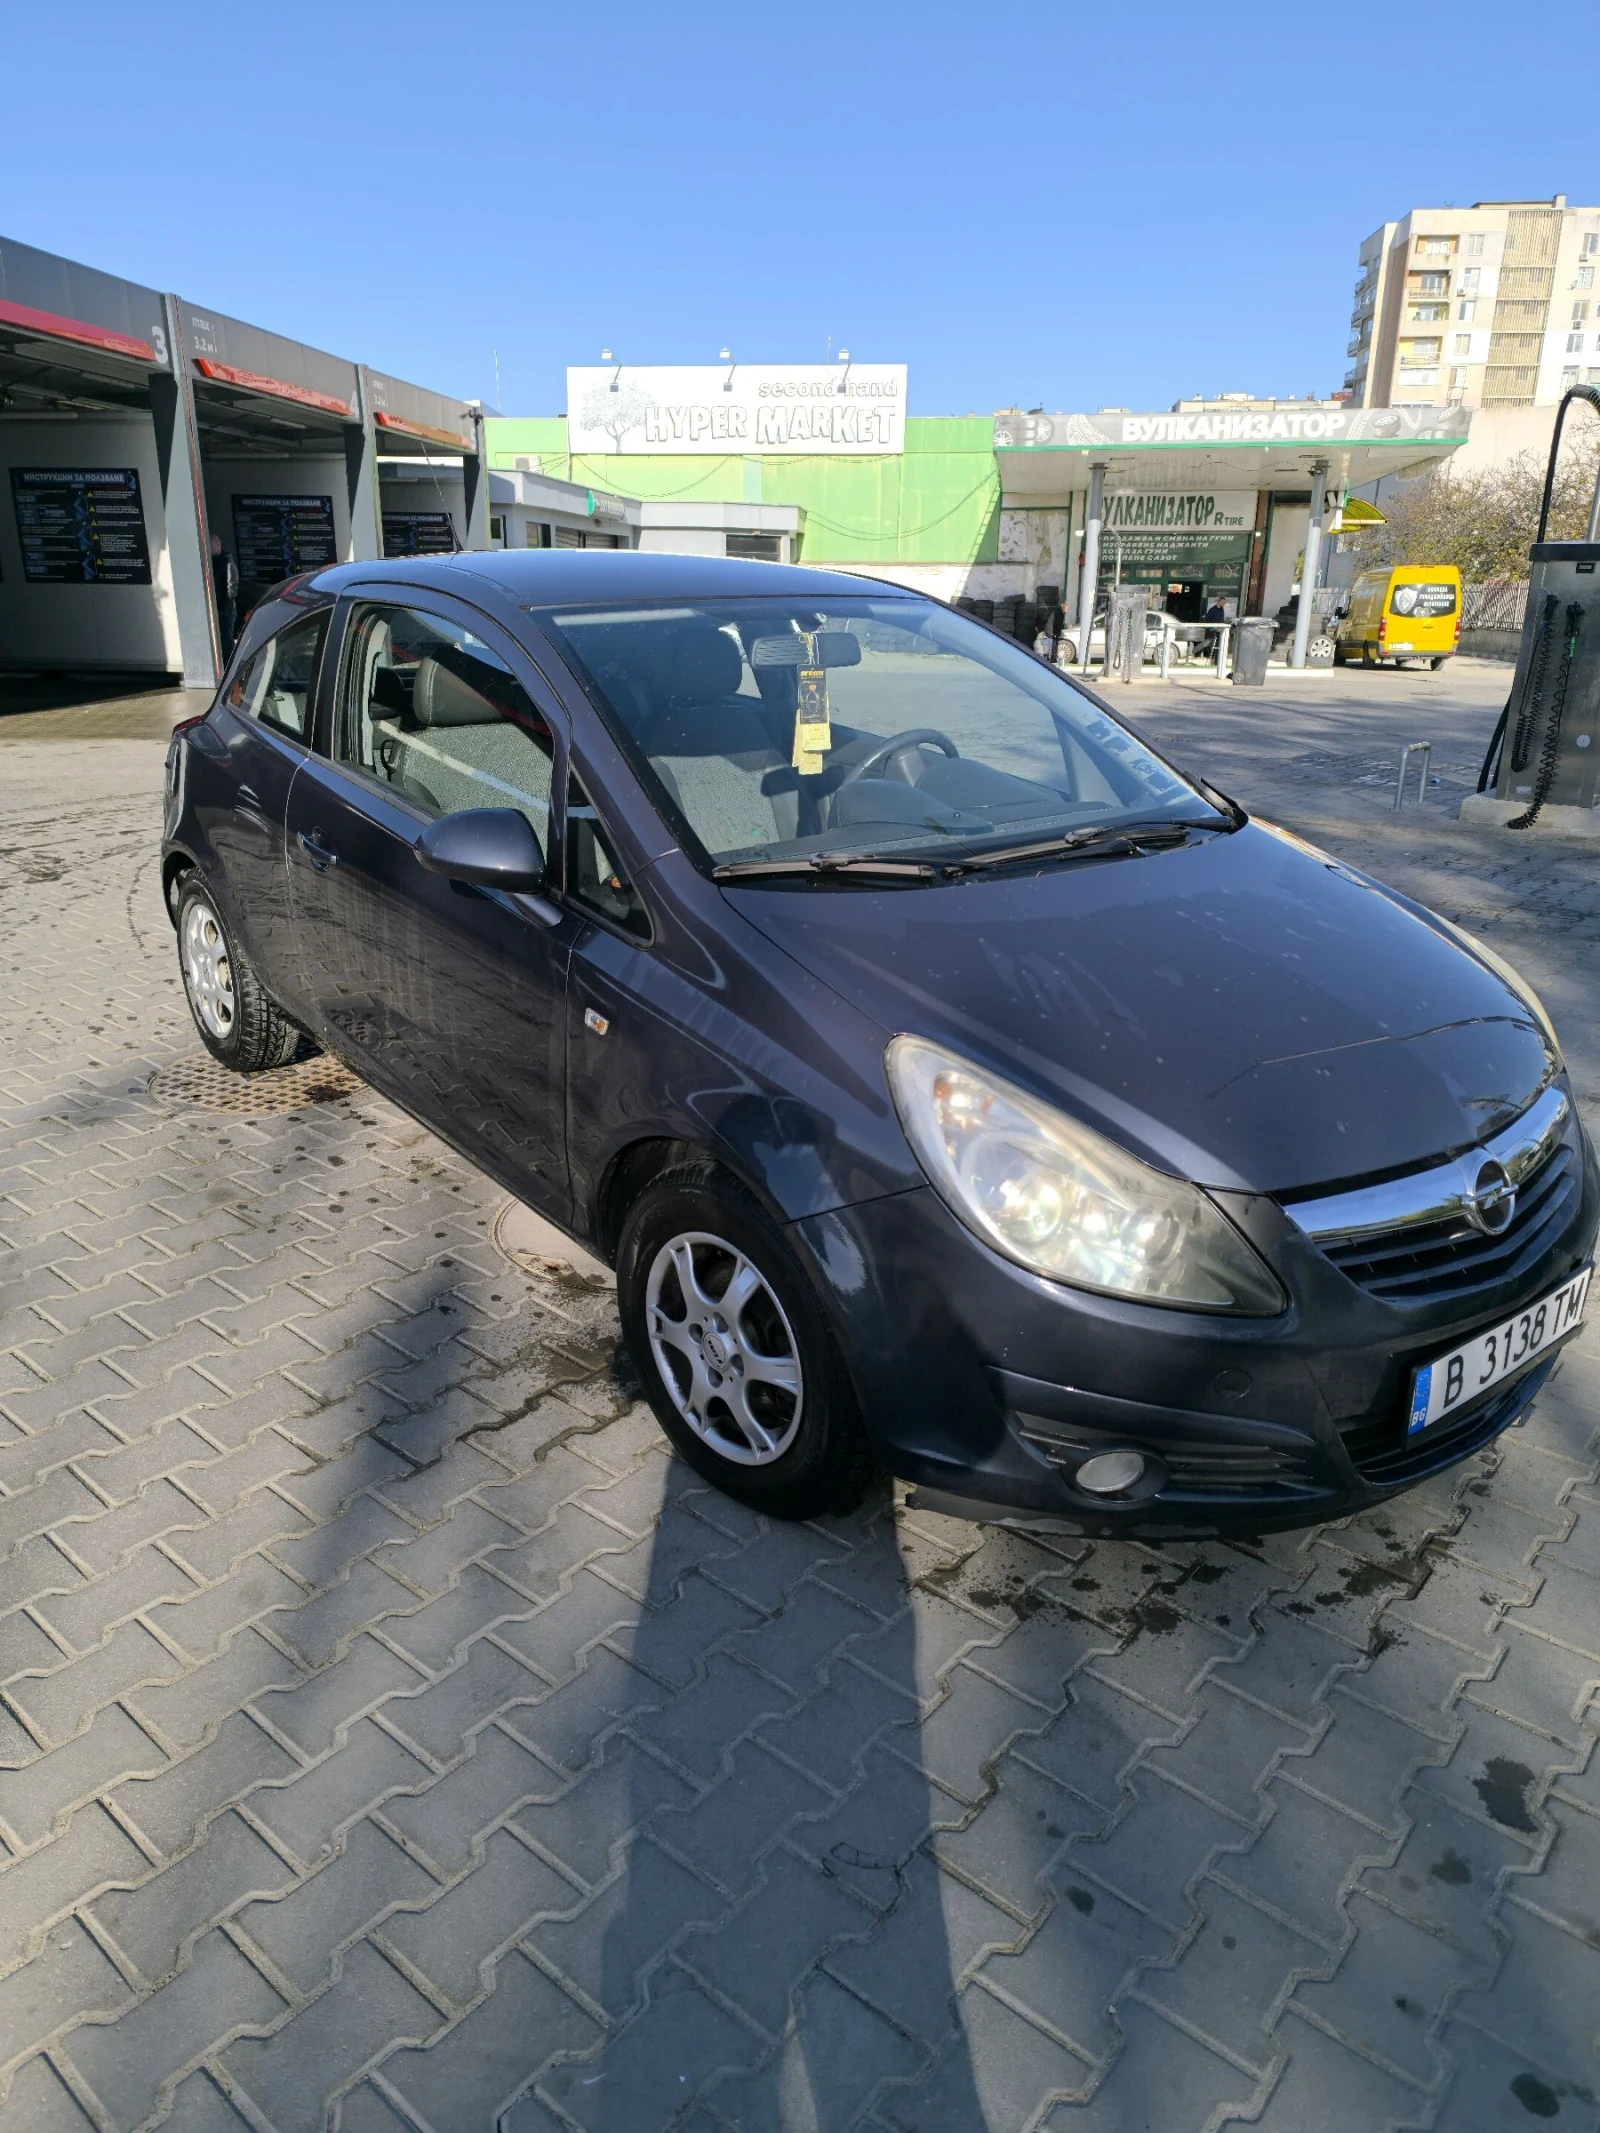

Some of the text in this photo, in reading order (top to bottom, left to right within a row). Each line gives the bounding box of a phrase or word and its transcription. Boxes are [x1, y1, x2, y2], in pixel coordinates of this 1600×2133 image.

[191, 316, 211, 331] max
[151, 325, 169, 364] 3
[758, 378, 898, 398] second hand
[349, 390, 360, 419] 4
[644, 405, 896, 444] HYPER MARKET
[1121, 413, 1346, 442] ВУЛКАНИЗАТОР
[23, 473, 73, 482] ИНСТРУКЦИИ
[84, 473, 125, 482] ПОЛЗВАНЕ
[1101, 495, 1215, 526] УЛКАНИЗАТОР
[1443, 1276, 1586, 1409] B 3138 TM
[1411, 1407, 1426, 1426] BG
